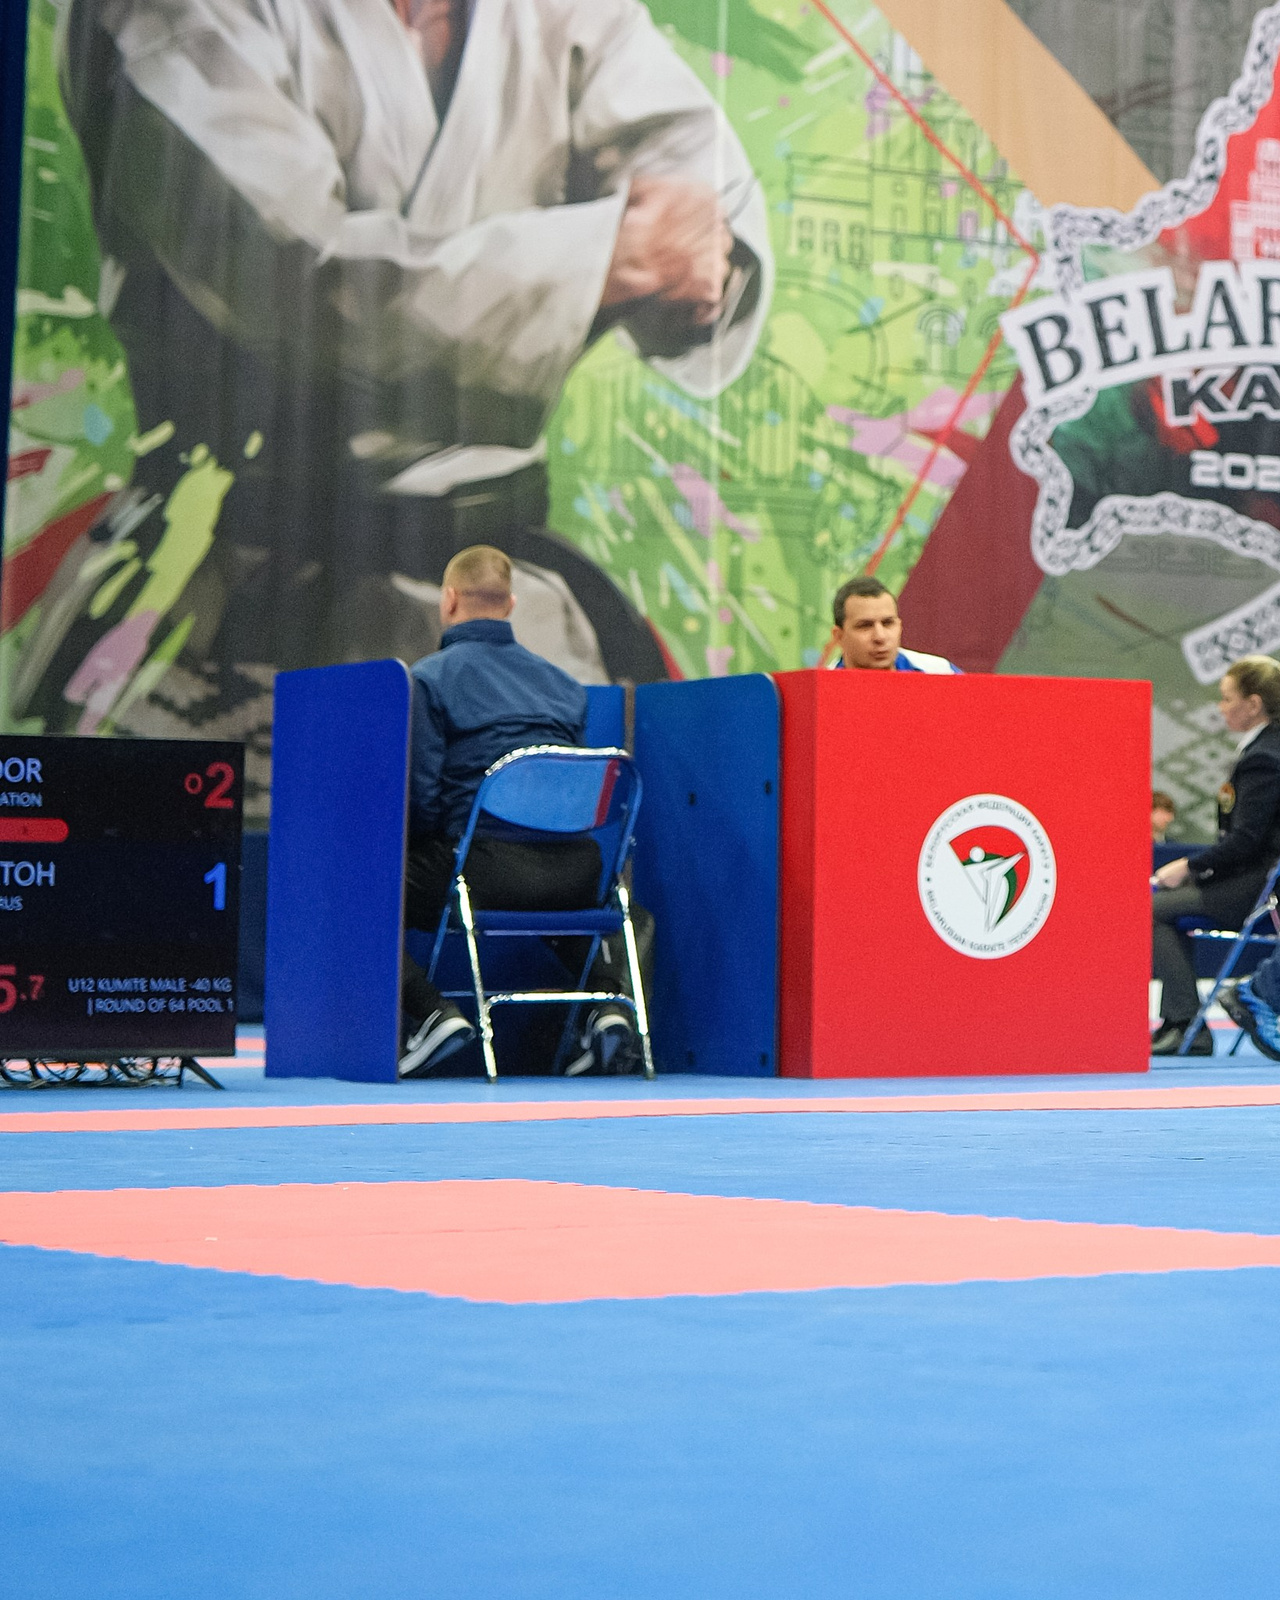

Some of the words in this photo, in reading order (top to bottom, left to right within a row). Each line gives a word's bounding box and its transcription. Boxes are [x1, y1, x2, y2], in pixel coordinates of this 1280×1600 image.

[0, 757, 43, 783] OR
[203, 862, 227, 911] 1
[67, 977, 95, 992] U12
[97, 977, 148, 992] KUMITE
[150, 977, 187, 992] MALE
[212, 977, 233, 992] KG
[95, 998, 146, 1013] ROUND
[147, 998, 167, 1013] OF
[187, 998, 225, 1013] POOL
